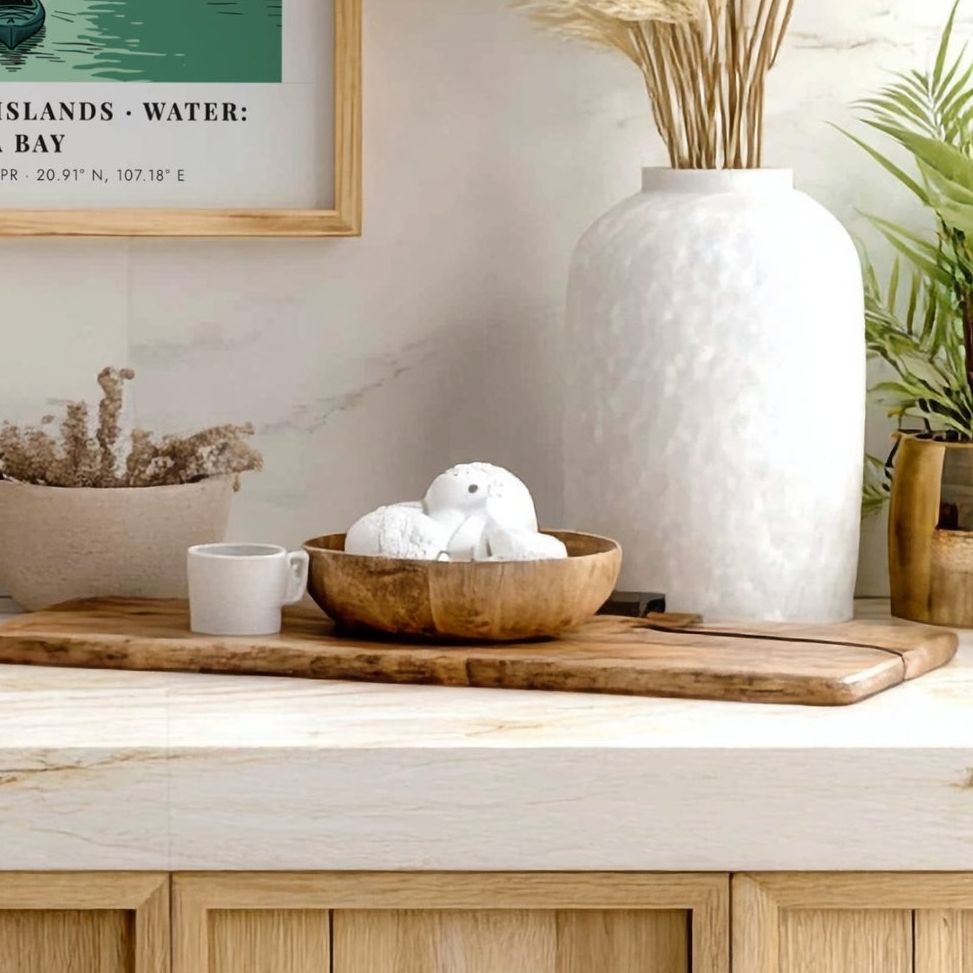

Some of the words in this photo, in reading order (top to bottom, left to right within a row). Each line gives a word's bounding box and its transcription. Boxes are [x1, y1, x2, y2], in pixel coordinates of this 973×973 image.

[142, 102, 248, 122] WATER:
[14, 134, 66, 154] BAY
[36, 168, 85, 182] 20.91°
[91, 168, 109, 184] N,
[116, 168, 171, 182] 107.18°
[177, 168, 186, 182] E
